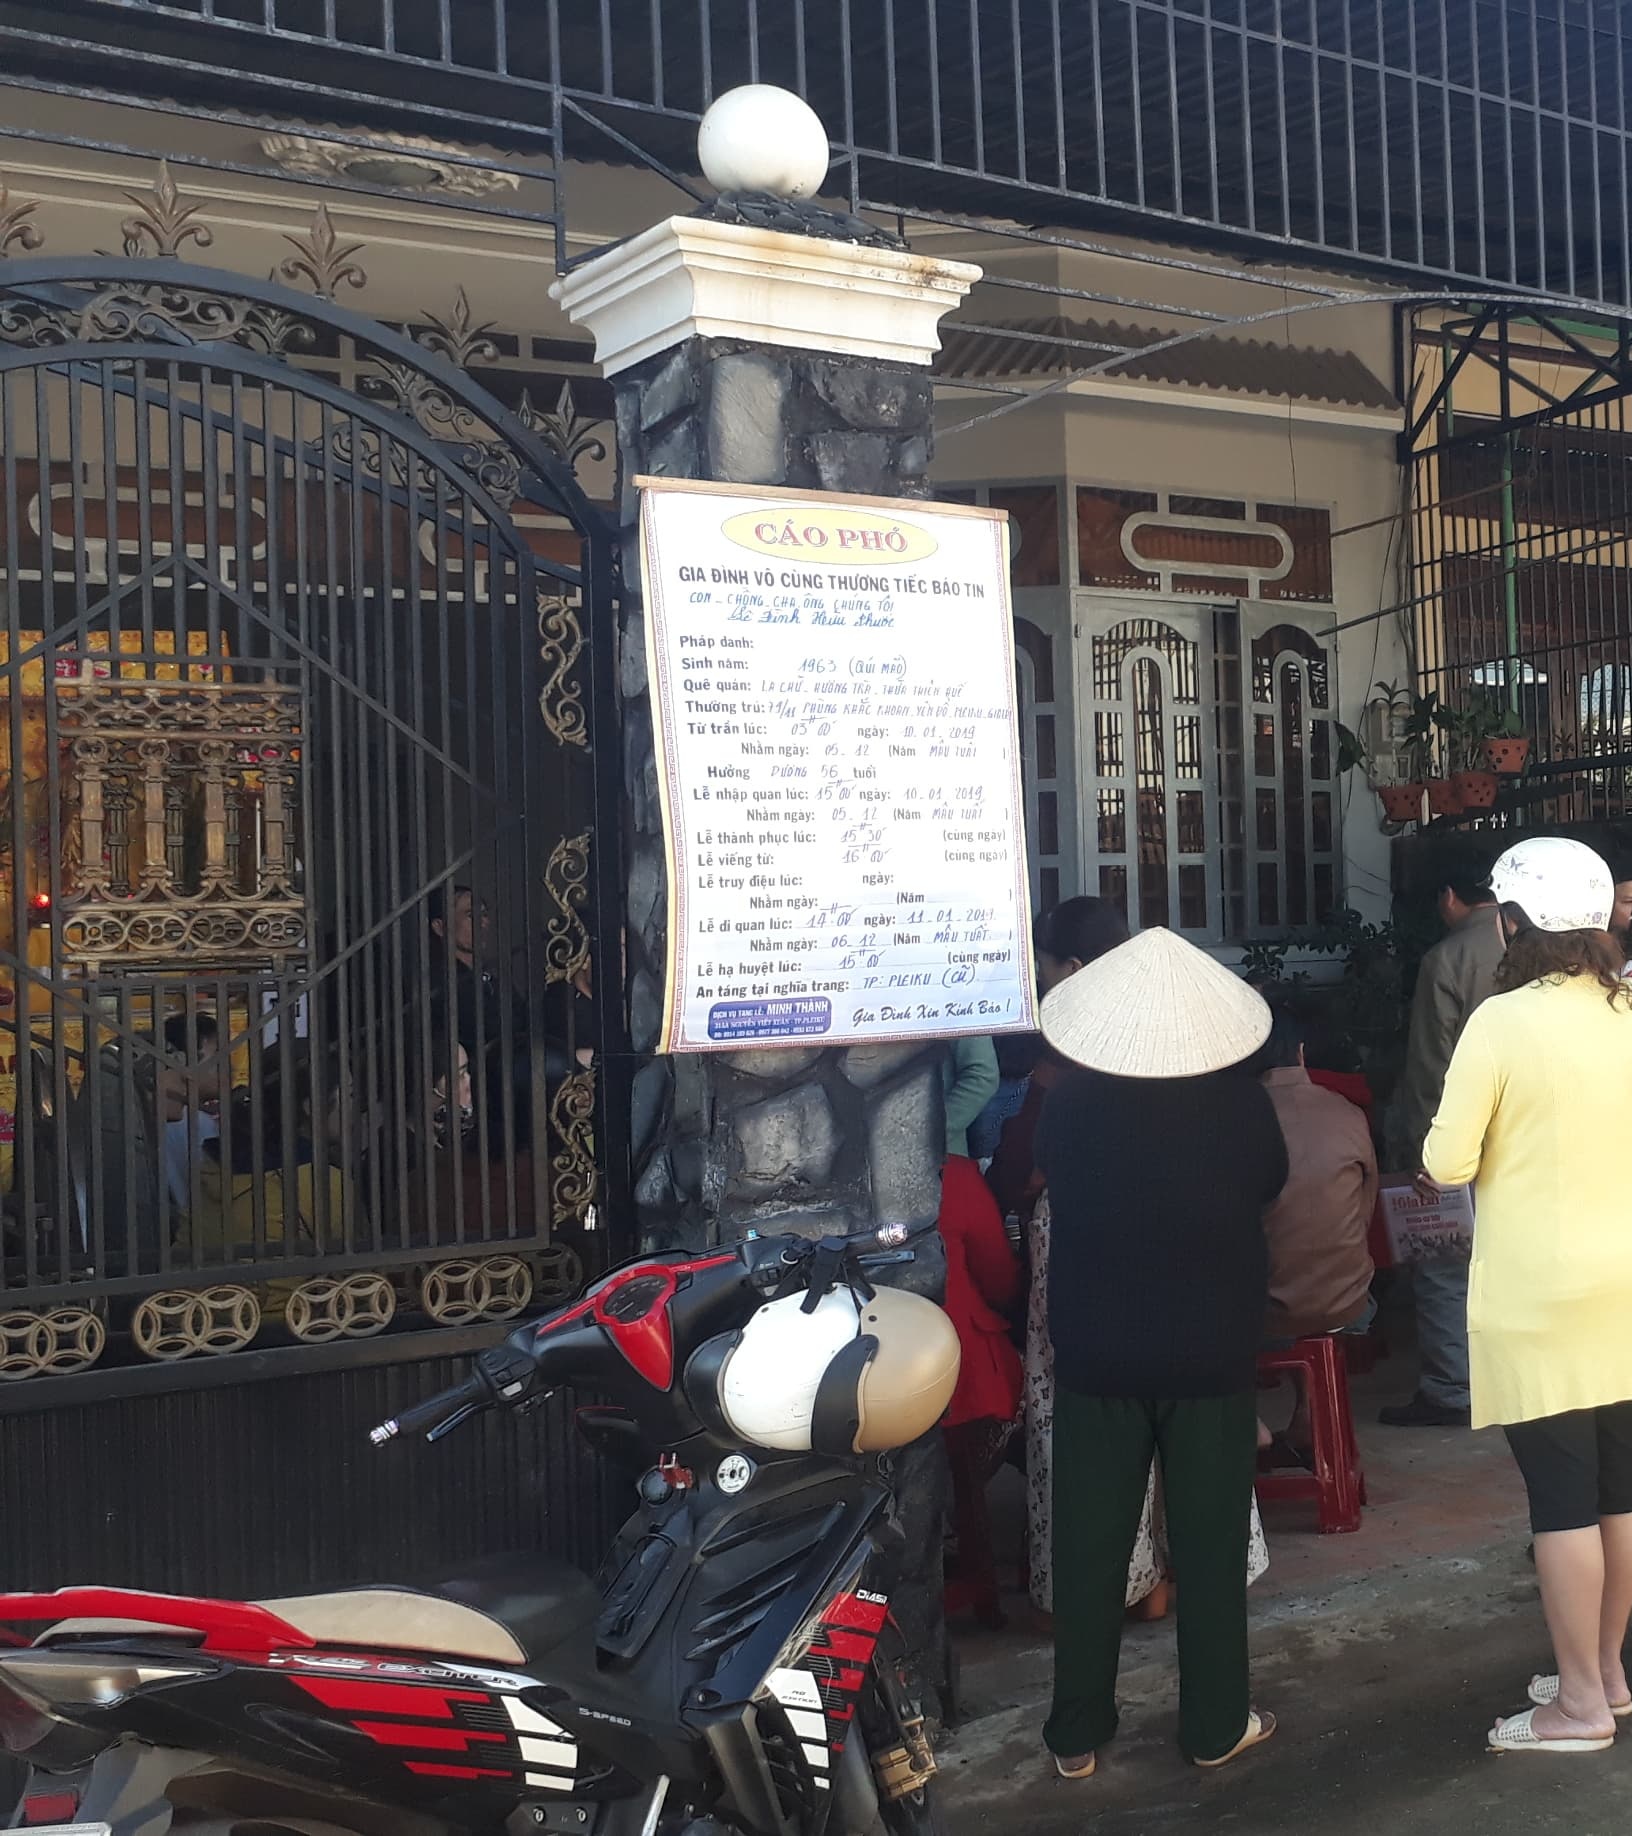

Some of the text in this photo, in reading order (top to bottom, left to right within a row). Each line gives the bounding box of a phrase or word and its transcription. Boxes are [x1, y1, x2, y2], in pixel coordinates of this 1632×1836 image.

[755, 519, 828, 547] CÁO
[679, 565, 984, 598] GIA ĐÌNH VÔ CÙNG THƯƠNG TIẾC BÁO TIN
[680, 635, 754, 648] Pháp danh:
[682, 657, 712, 669] Sinh
[718, 659, 748, 669] năm:
[798, 659, 836, 673] 1963
[684, 679, 710, 691] Quê
[717, 679, 751, 692] quán:
[686, 700, 736, 714] Thường
[688, 722, 706, 734] Từ
[711, 721, 739, 734] trần
[744, 723, 767, 734] lúc:
[858, 725, 888, 738] ngày:
[741, 741, 774, 755] Nhằm
[779, 744, 809, 757] ngày:
[708, 764, 750, 780] Hưởng
[854, 764, 876, 778] tuổi
[693, 786, 710, 800] Lễ
[716, 788, 747, 802] nhập
[753, 791, 781, 801] quan
[786, 788, 808, 799] lúc:
[859, 788, 890, 801] ngày:
[747, 807, 779, 821] Nhằm
[784, 809, 815, 822] ngày:
[697, 829, 1005, 845] Lễ thành phục lúc: (cùng ngày)
[698, 852, 713, 866] Lễ
[719, 852, 752, 867] viếng
[945, 850, 975, 862] (cùng
[699, 872, 893, 889] Lễ truy điệu lúc: ngày:
[750, 894, 782, 909] Nhằm
[787, 895, 818, 909] ngày:
[699, 918, 714, 932] Lễ
[736, 921, 764, 933] quan
[770, 918, 792, 929] lúc:
[864, 913, 896, 927] ngày:
[750, 937, 782, 952] Nhằm
[787, 937, 817, 951] ngày:
[698, 949, 1010, 978] Lễ hạ huyệt lúc: (cùng ngày)
[696, 986, 713, 998] An
[718, 985, 747, 998] táng
[752, 983, 769, 997] tại
[774, 981, 807, 995] nghĩa
[812, 981, 849, 993] trang:
[889, 973, 931, 987] PLEIKU
[766, 1003, 792, 1015] MINH
[794, 998, 828, 1013] THÀNH
[853, 1008, 875, 1027] Gia
[917, 1004, 939, 1018] Xin
[945, 1001, 973, 1016] Kính
